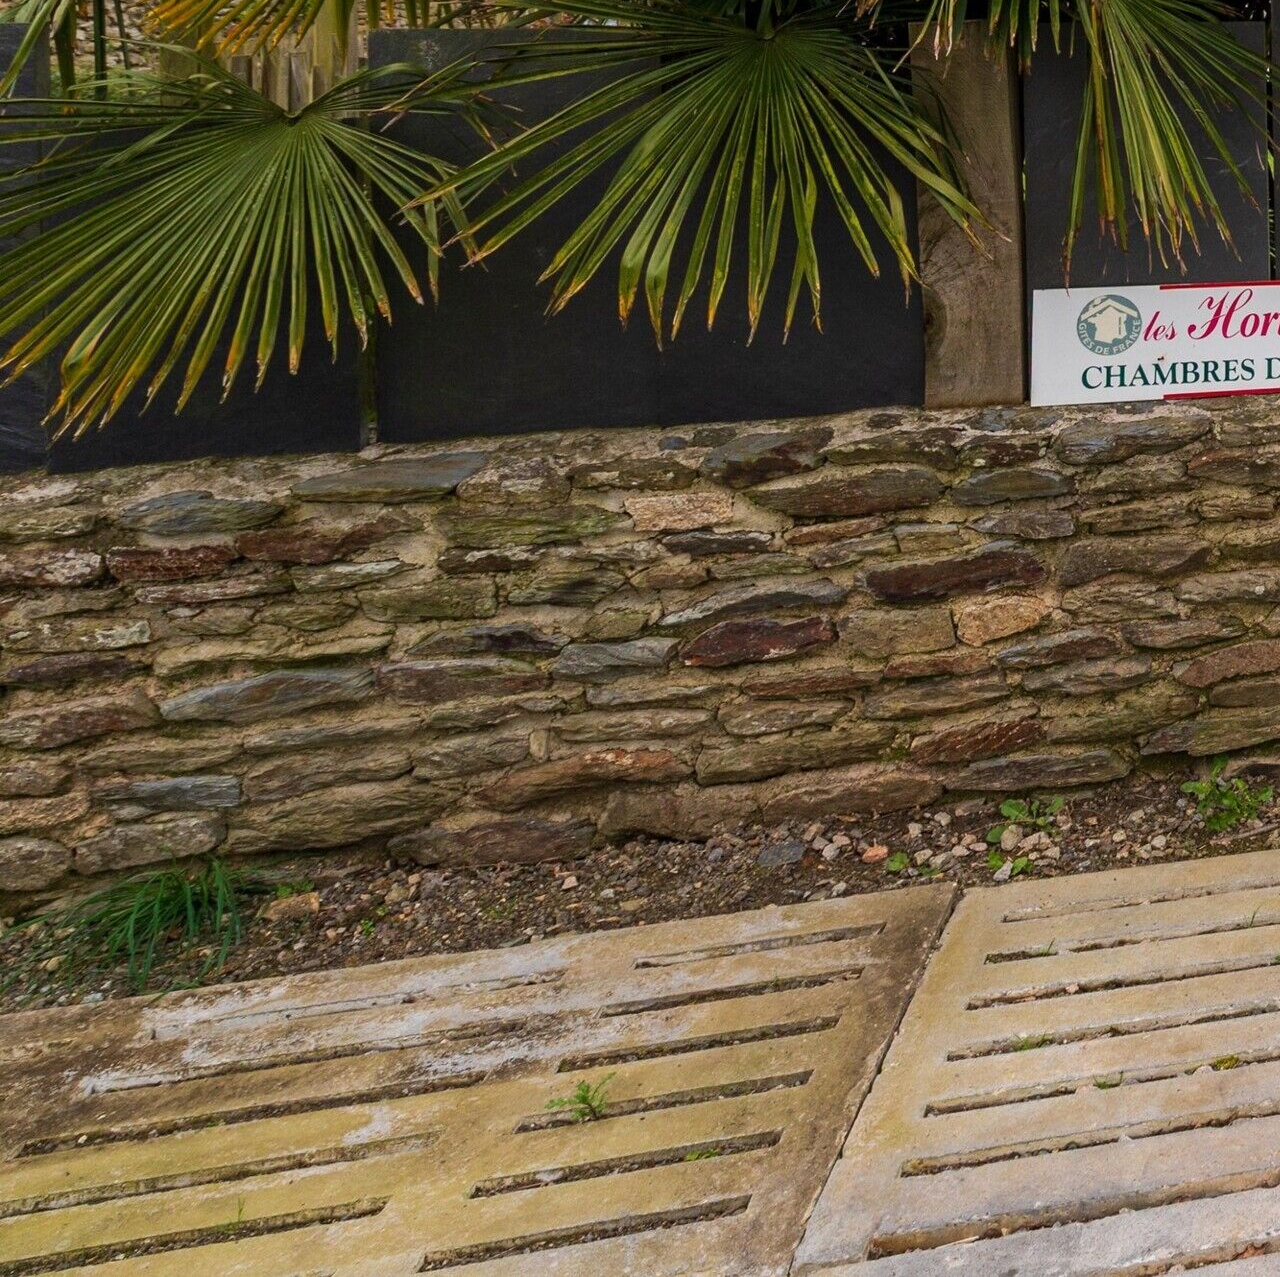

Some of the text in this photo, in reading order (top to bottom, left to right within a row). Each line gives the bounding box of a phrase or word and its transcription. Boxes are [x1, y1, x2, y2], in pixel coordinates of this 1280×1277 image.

[1095, 346, 1110, 355] DE
[1113, 319, 1141, 353] FRANCE
[1143, 311, 1176, 341] les
[1081, 358, 1255, 390] CHAMBRES
